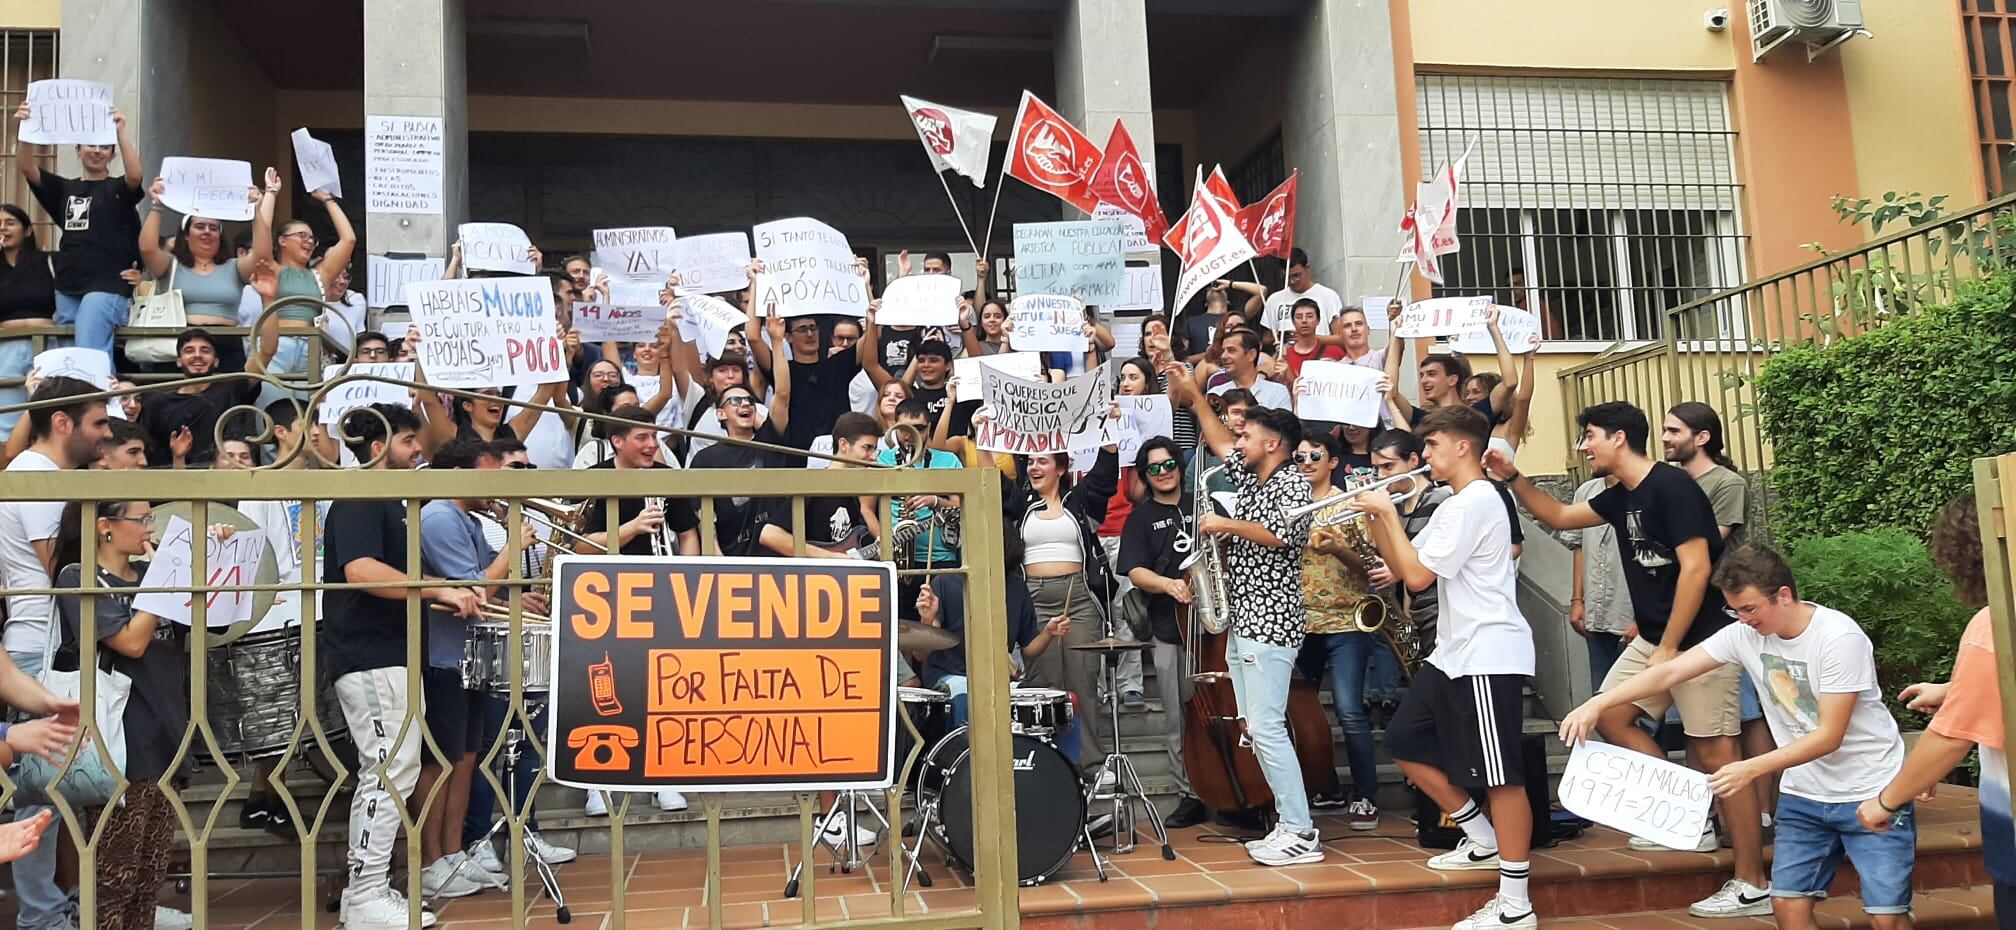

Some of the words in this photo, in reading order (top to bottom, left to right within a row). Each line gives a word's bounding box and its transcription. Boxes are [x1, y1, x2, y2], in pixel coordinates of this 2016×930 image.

[371, 199, 429, 209] DIGNIDAD
[760, 231, 776, 248] SI
[781, 230, 815, 244] TANTO
[761, 256, 817, 275] NUESTRO
[763, 271, 860, 305] APÓYALO
[424, 323, 442, 338] DE
[442, 316, 490, 340] CULTURA
[530, 320, 546, 335] LA
[1017, 325, 1036, 338] SE
[505, 336, 560, 376] POCO
[345, 384, 378, 401] CON
[989, 374, 1001, 391] SI
[1051, 384, 1077, 399] QUE
[1134, 397, 1154, 412] NO
[571, 571, 655, 640] SE
[669, 571, 882, 640] VENDE
[719, 652, 802, 705] FALTA
[816, 655, 863, 700] DE
[655, 715, 854, 768] PERSONAL
[1012, 750, 1036, 767] arl
[1585, 751, 1645, 786] CSM
